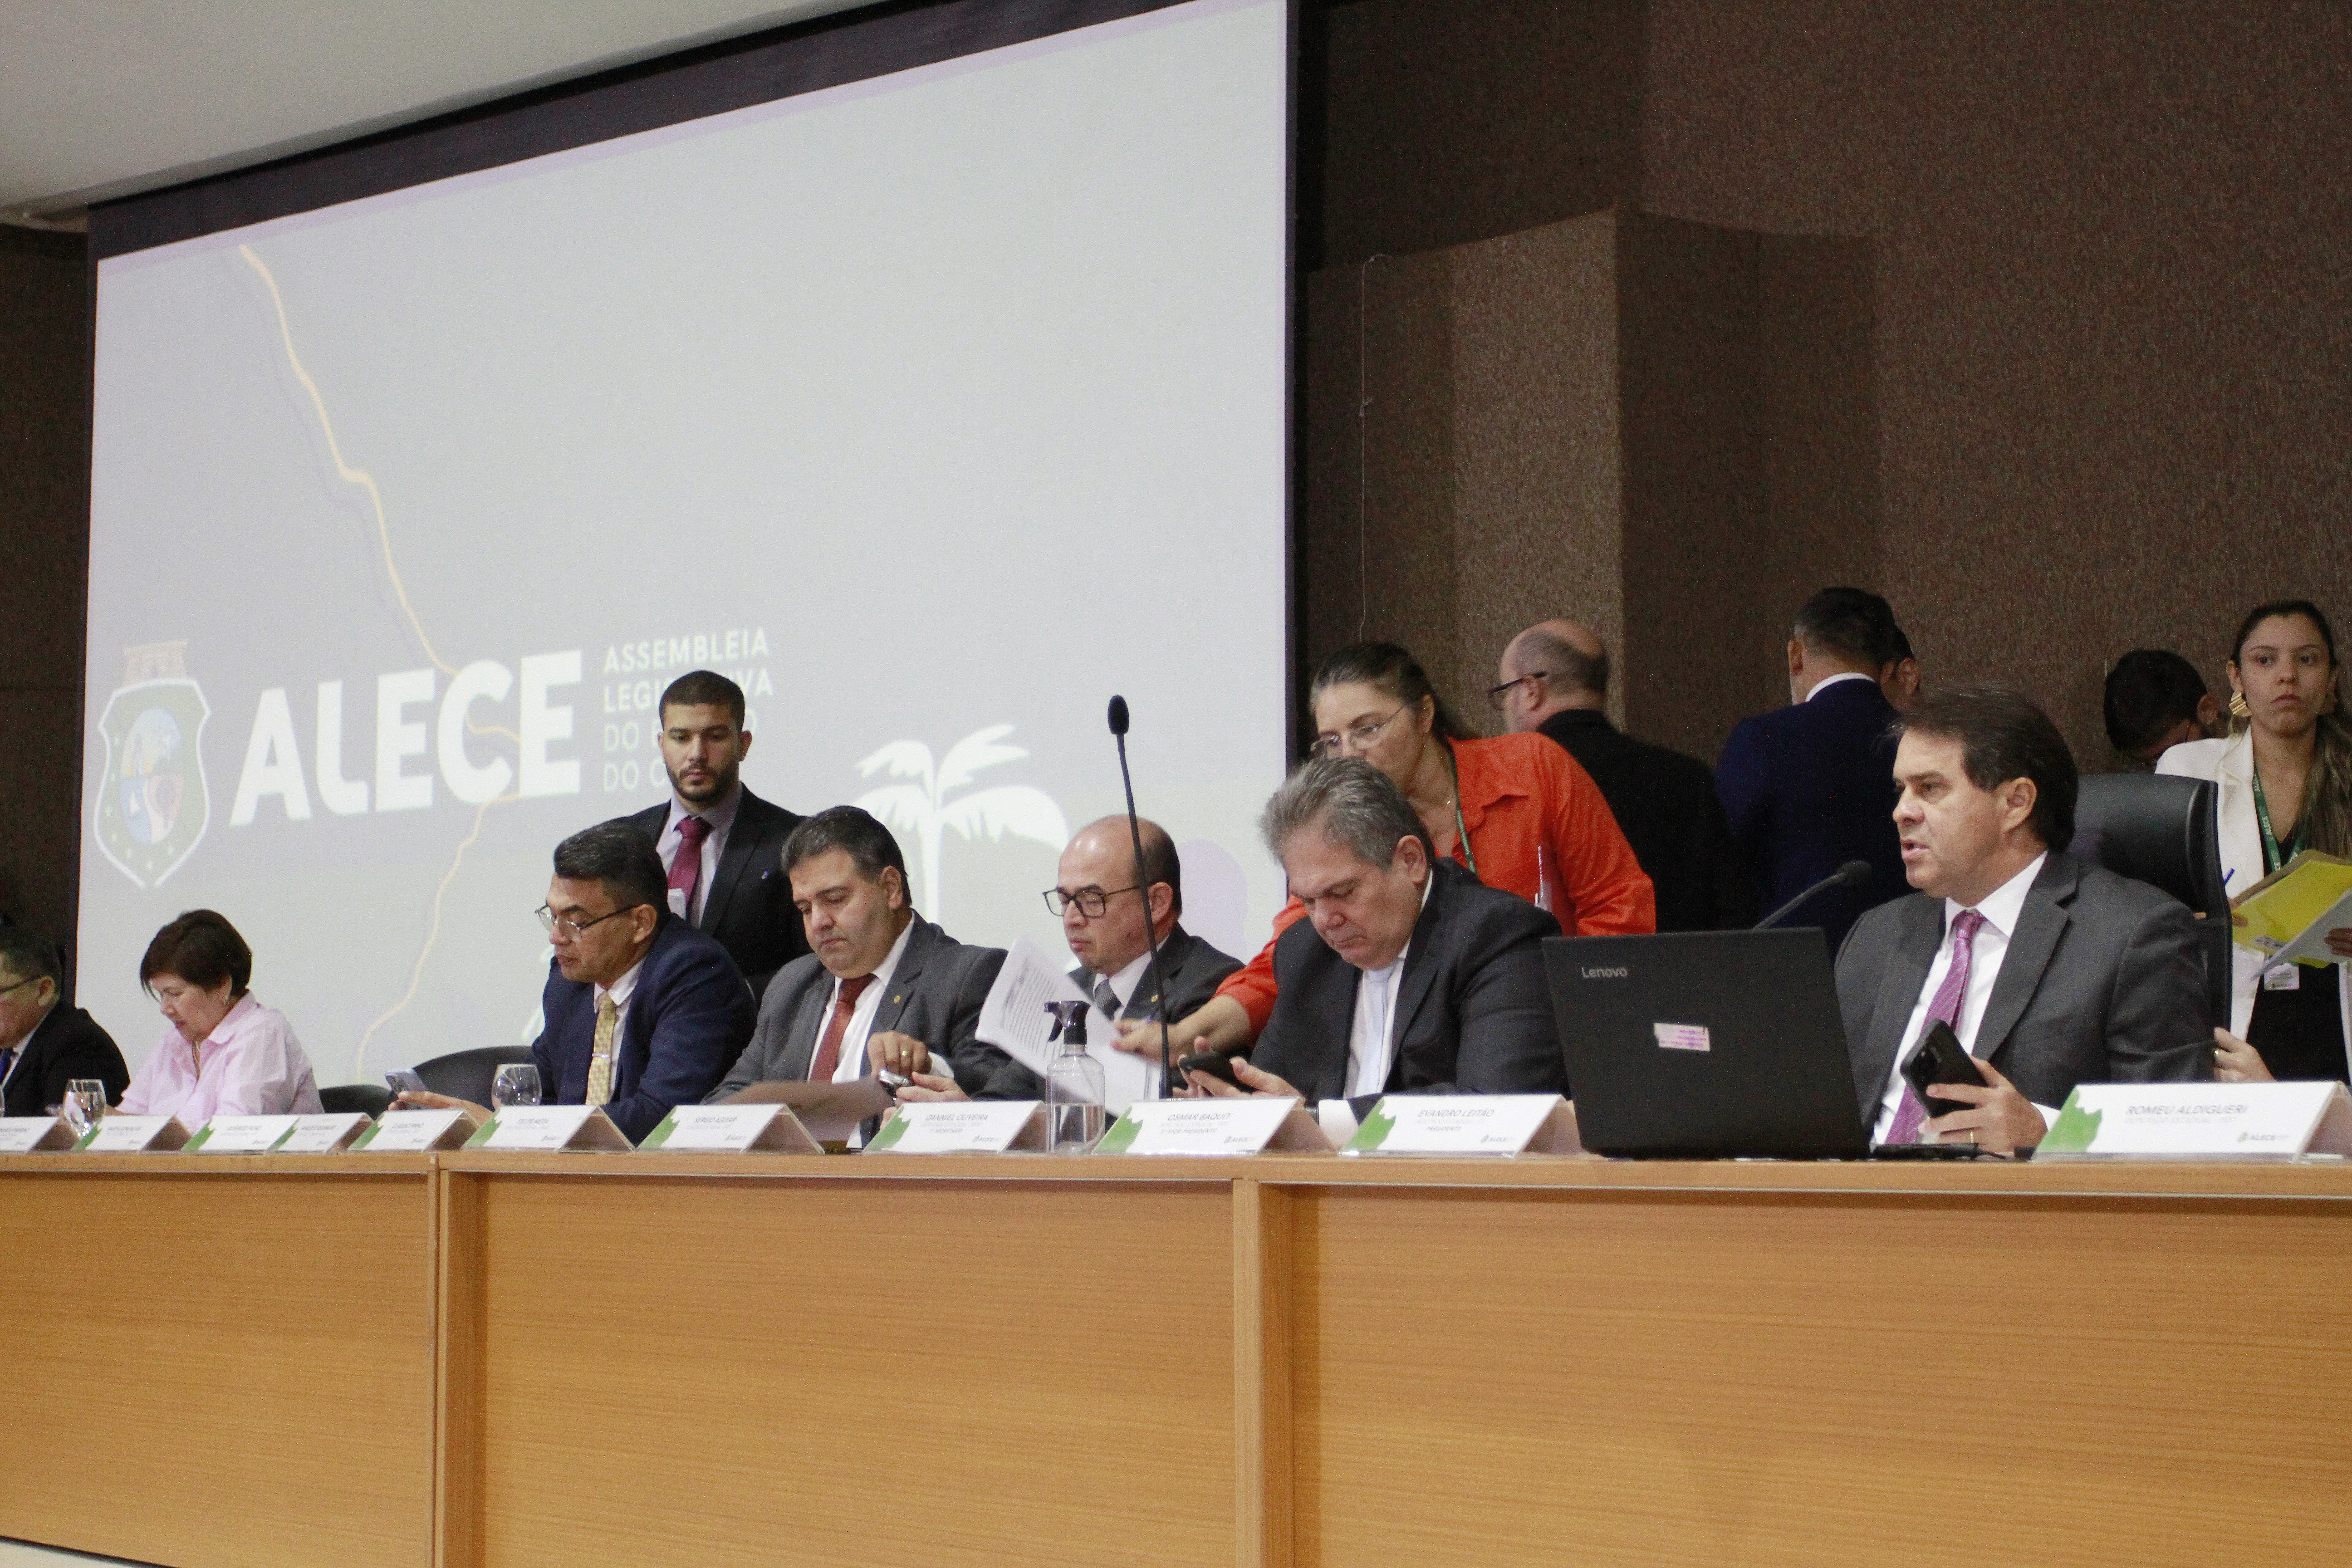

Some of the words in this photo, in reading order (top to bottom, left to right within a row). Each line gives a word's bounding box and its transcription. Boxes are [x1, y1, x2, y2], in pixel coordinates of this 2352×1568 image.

[603, 626, 769, 675] ASSEMBLEIA
[229, 649, 583, 828] ALECE
[604, 722, 639, 752] DO
[603, 761, 639, 792] DO
[1582, 967, 1628, 979] Lenovo
[1199, 1112, 1232, 1121] BAQUIT
[1462, 1108, 1494, 1117] LEITÃO
[2126, 1105, 2175, 1114] ROMEU
[2176, 1104, 2249, 1114] ALDIGUERI
